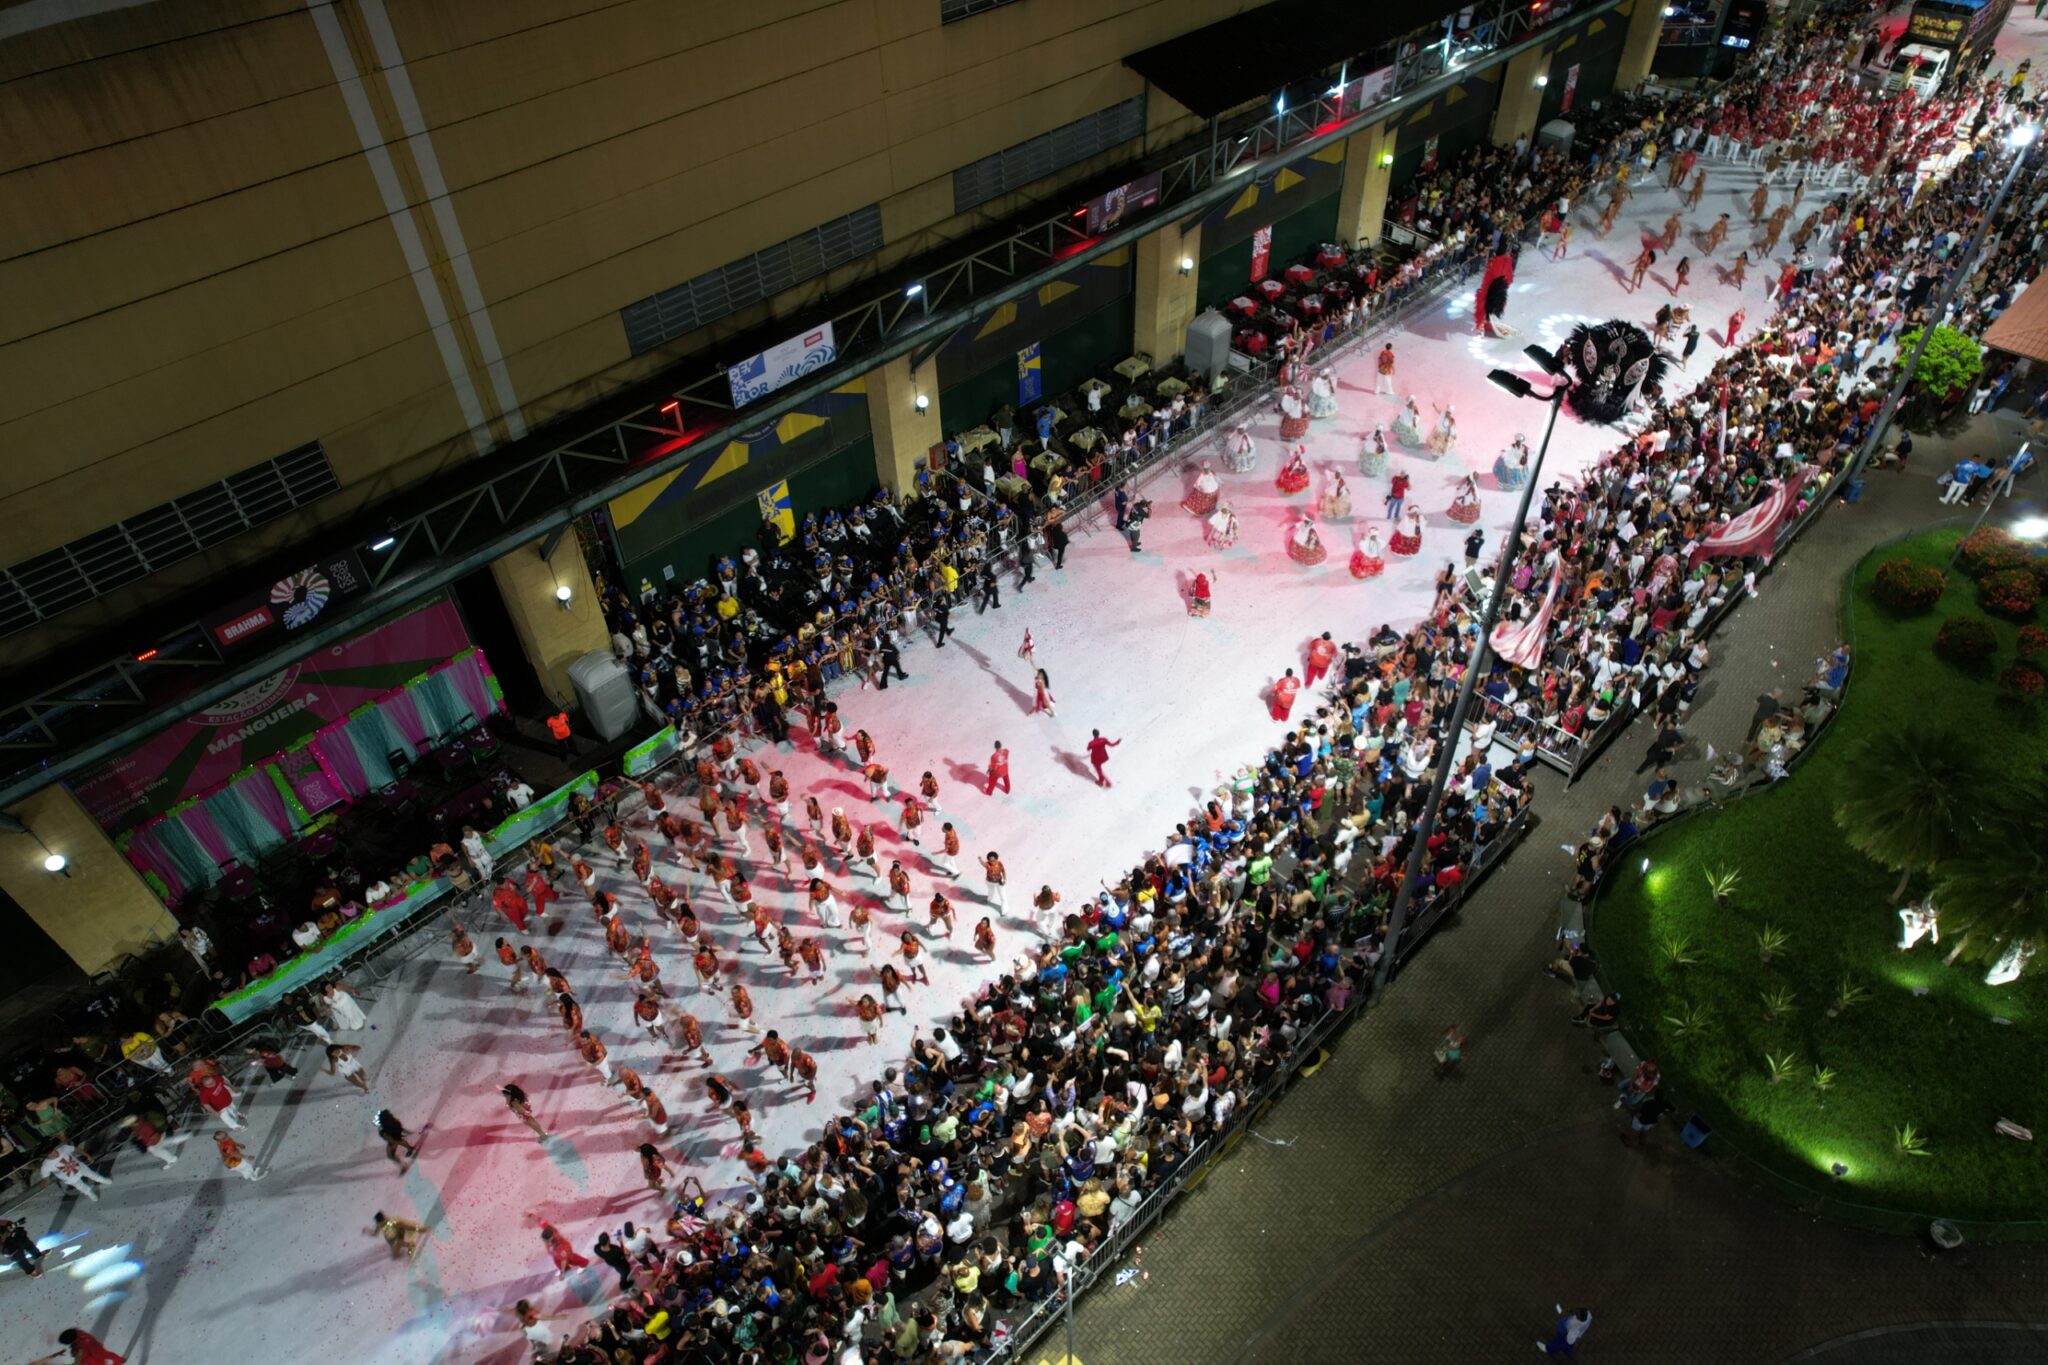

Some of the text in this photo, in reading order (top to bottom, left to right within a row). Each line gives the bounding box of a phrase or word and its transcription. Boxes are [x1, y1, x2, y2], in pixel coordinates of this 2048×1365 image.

[734, 382, 768, 407] FLOR
[223, 612, 267, 640] BRAHMA
[256, 677, 293, 713] PRIMEIRA
[206, 692, 320, 756] MANGUEIRA
